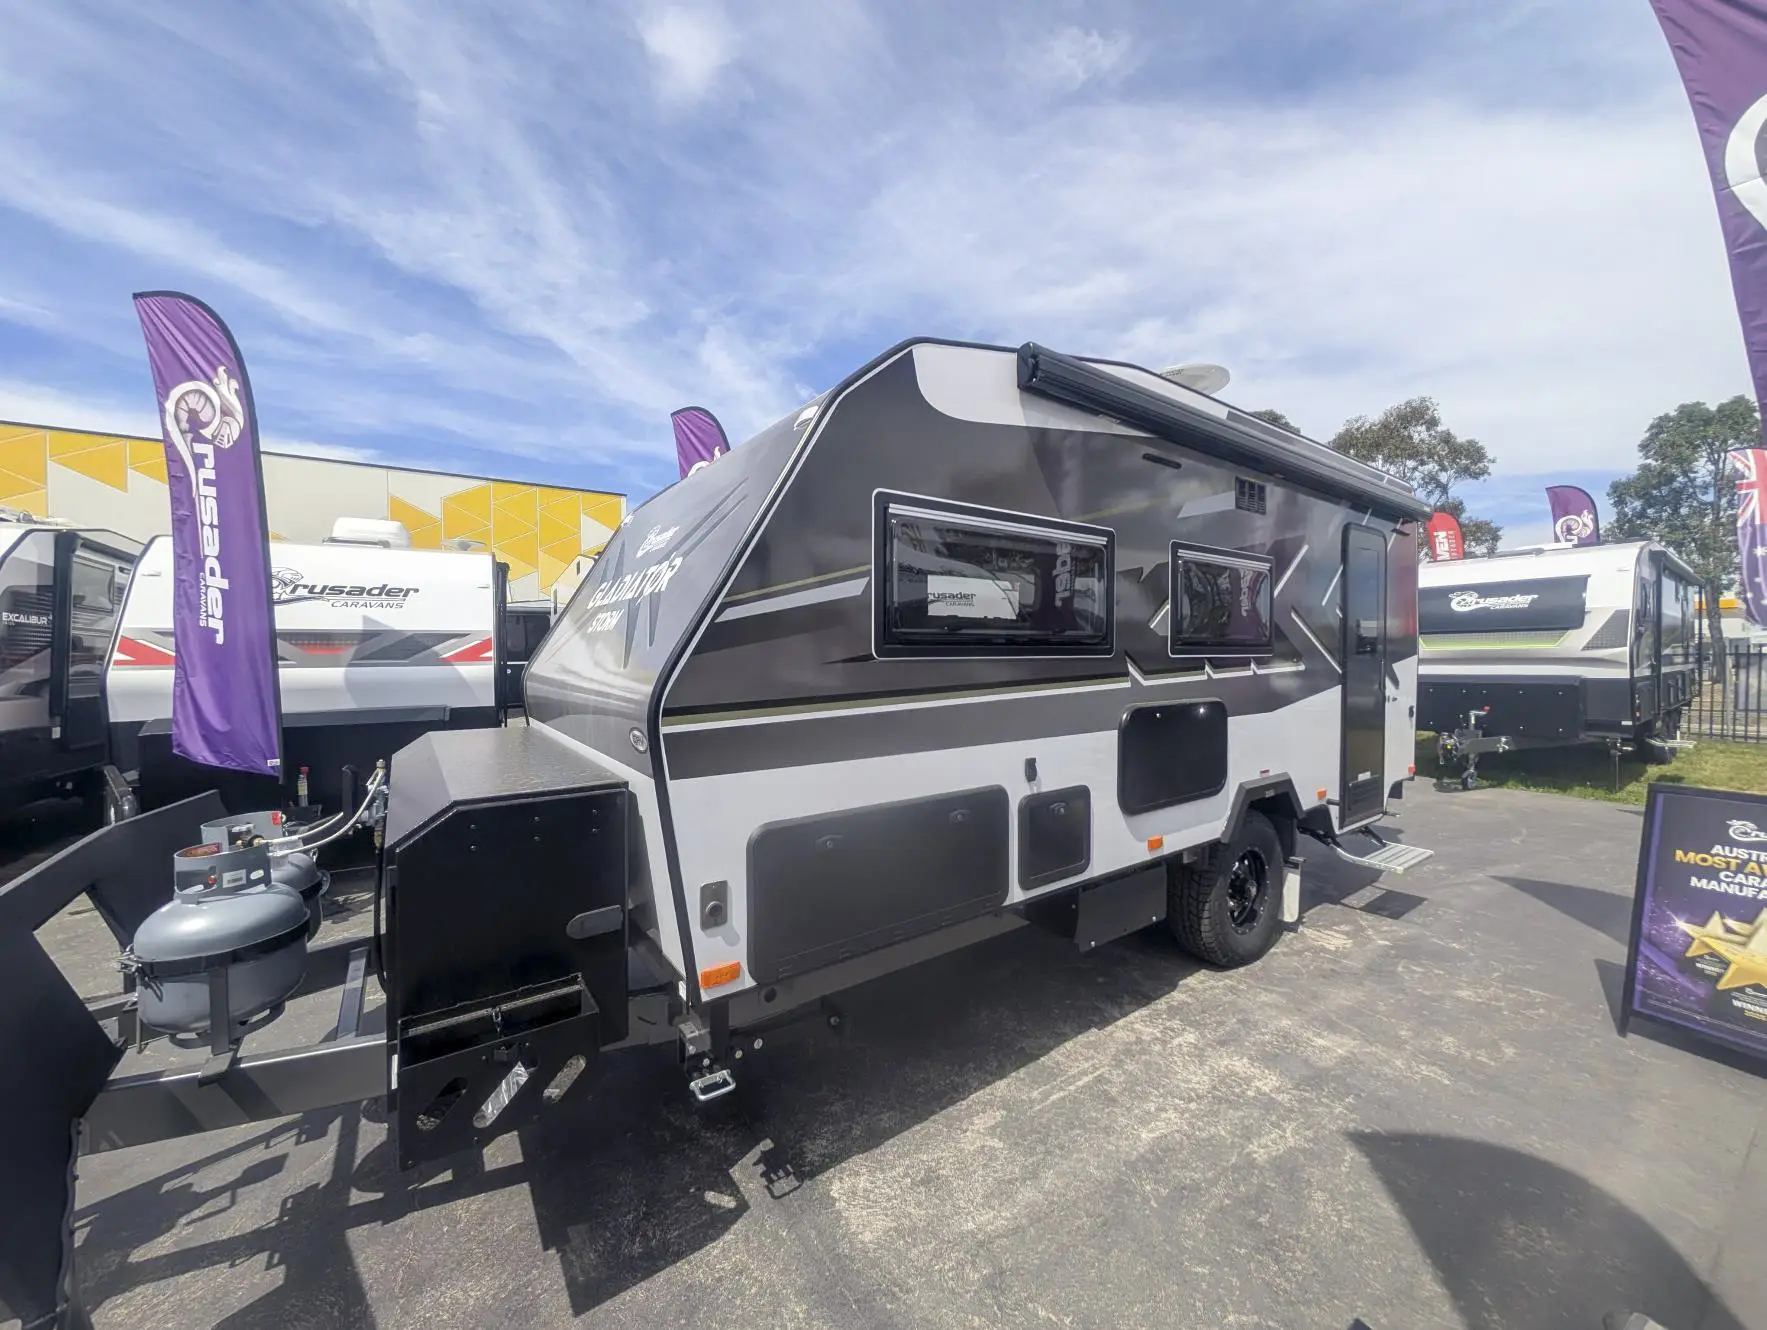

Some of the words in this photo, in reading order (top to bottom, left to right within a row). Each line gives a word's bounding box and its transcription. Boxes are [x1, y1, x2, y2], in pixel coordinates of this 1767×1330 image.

[587, 552, 683, 609] GLADIATOR
[331, 600, 405, 609] CARAVANS
[2, 611, 48, 625] EXCALIBUR
[587, 608, 625, 633] STORM
[1674, 848, 1742, 871] MOST
